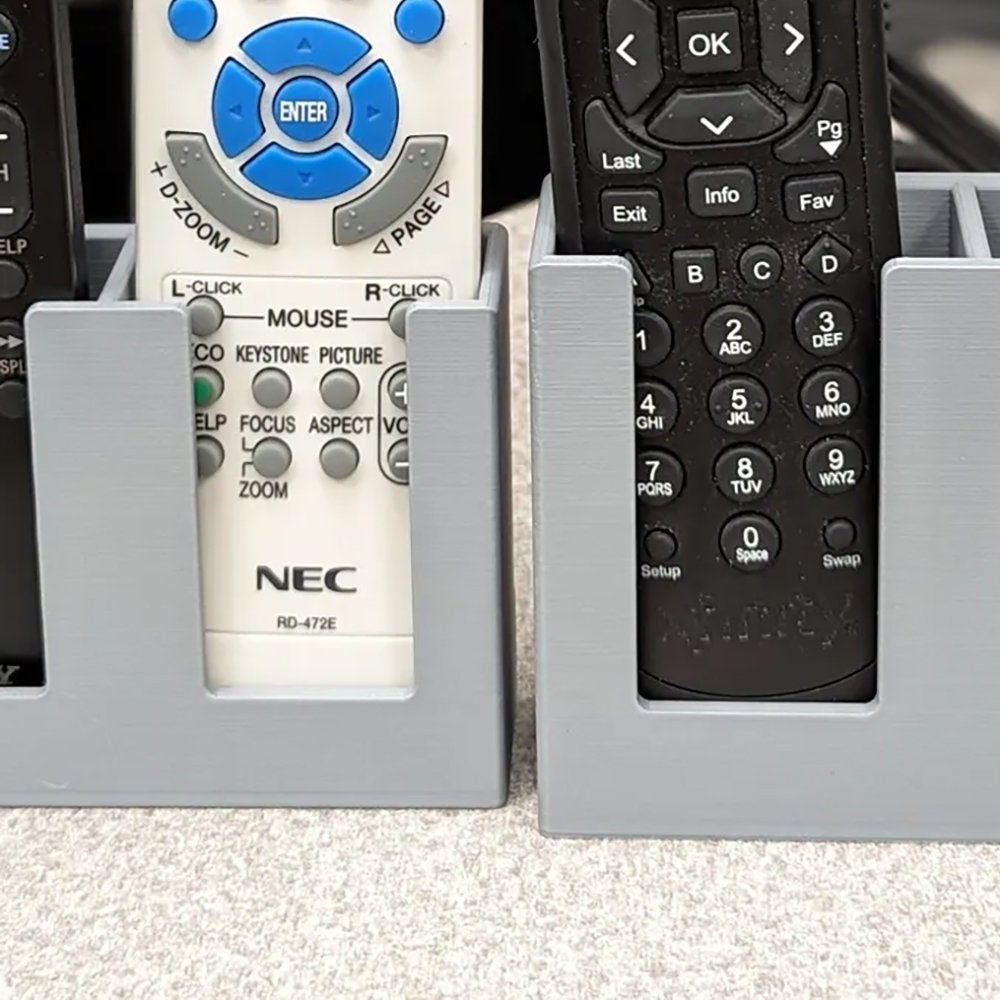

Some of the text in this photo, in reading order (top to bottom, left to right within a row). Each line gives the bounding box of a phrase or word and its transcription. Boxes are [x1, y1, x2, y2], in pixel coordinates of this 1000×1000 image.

[688, 32, 731, 57] OK
[280, 102, 328, 122] ENTER
[817, 121, 843, 139] Pg
[602, 153, 641, 169] Last
[705, 187, 740, 204] Info
[799, 194, 834, 211] Fav
[159, 181, 231, 252] D-ZOOM
[391, 197, 442, 247] PAGE
[613, 206, 647, 223] Exit
[688, 265, 703, 283] B
[754, 262, 771, 279] C
[821, 256, 838, 274] D
[172, 280, 242, 297] L-CLICK
[365, 284, 440, 300] R-CLICK
[268, 309, 348, 328] MOUSE
[818, 312, 834, 332] 3
[726, 319, 742, 340] 2
[636, 330, 647, 350] 1
[719, 341, 752, 355] ABC
[812, 333, 842, 348] DEF
[194, 344, 225, 361] CO
[236, 346, 309, 364] KEYSTONE
[319, 347, 383, 365] PICTURE
[731, 389, 747, 410] 5
[824, 381, 839, 402] 6
[640, 394, 655, 414] 4
[815, 402, 851, 419] MNO
[195, 414, 227, 432] ELP
[240, 415, 296, 433] FOCUS
[308, 417, 374, 434] ASPECT
[636, 416, 663, 430] GHI
[727, 412, 754, 425] JKL
[737, 457, 753, 479] 8
[828, 449, 844, 470] 9
[645, 460, 660, 481] 7
[819, 470, 856, 487] WXYZ
[239, 481, 288, 500] ZOOM
[637, 482, 673, 497] PQRS
[731, 480, 762, 494] TUV
[743, 527, 759, 548] 0
[736, 548, 769, 565] Space
[823, 552, 862, 568] Swap
[256, 565, 357, 593] NEC
[641, 564, 681, 580] Setup
[277, 617, 336, 630] RD-472E
